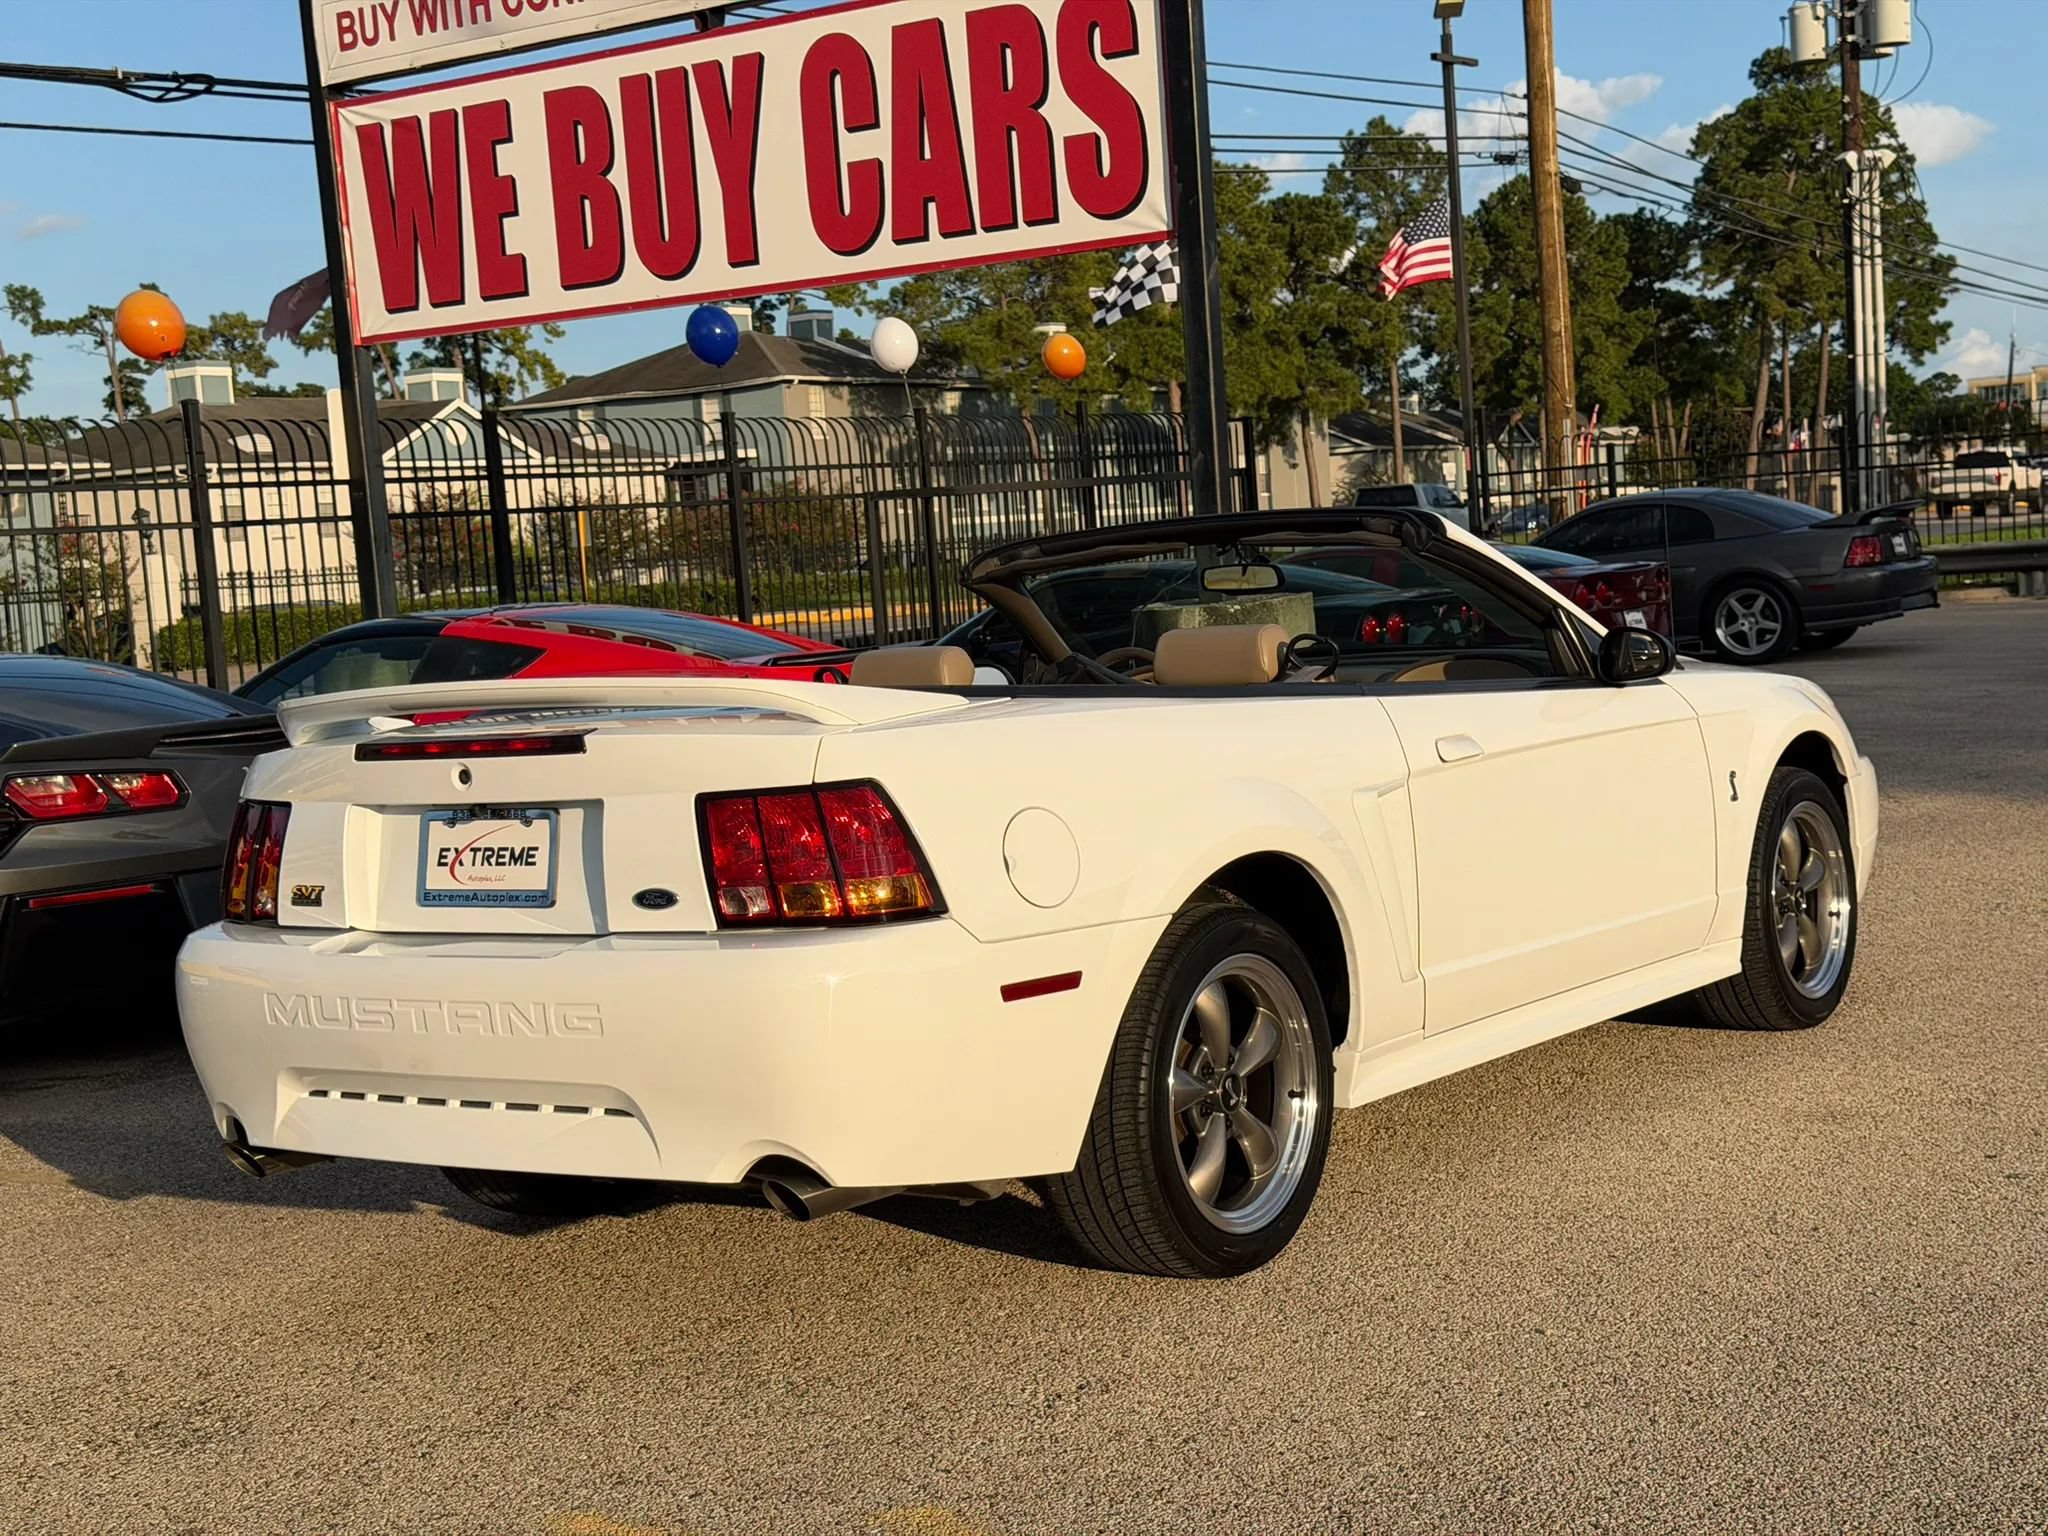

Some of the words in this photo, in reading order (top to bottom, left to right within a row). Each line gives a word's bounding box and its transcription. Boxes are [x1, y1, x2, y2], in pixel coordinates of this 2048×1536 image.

[336, 0, 399, 52] BUY
[356, 99, 529, 314] WE
[543, 51, 765, 290] BUY
[800, 0, 1149, 257] CARS
[437, 846, 539, 867] EXTREME
[291, 885, 325, 900] SVT
[424, 891, 548, 903] ExtremeAutoplex.com
[643, 893, 668, 905] Ford
[263, 992, 603, 1038] MUSTANG
